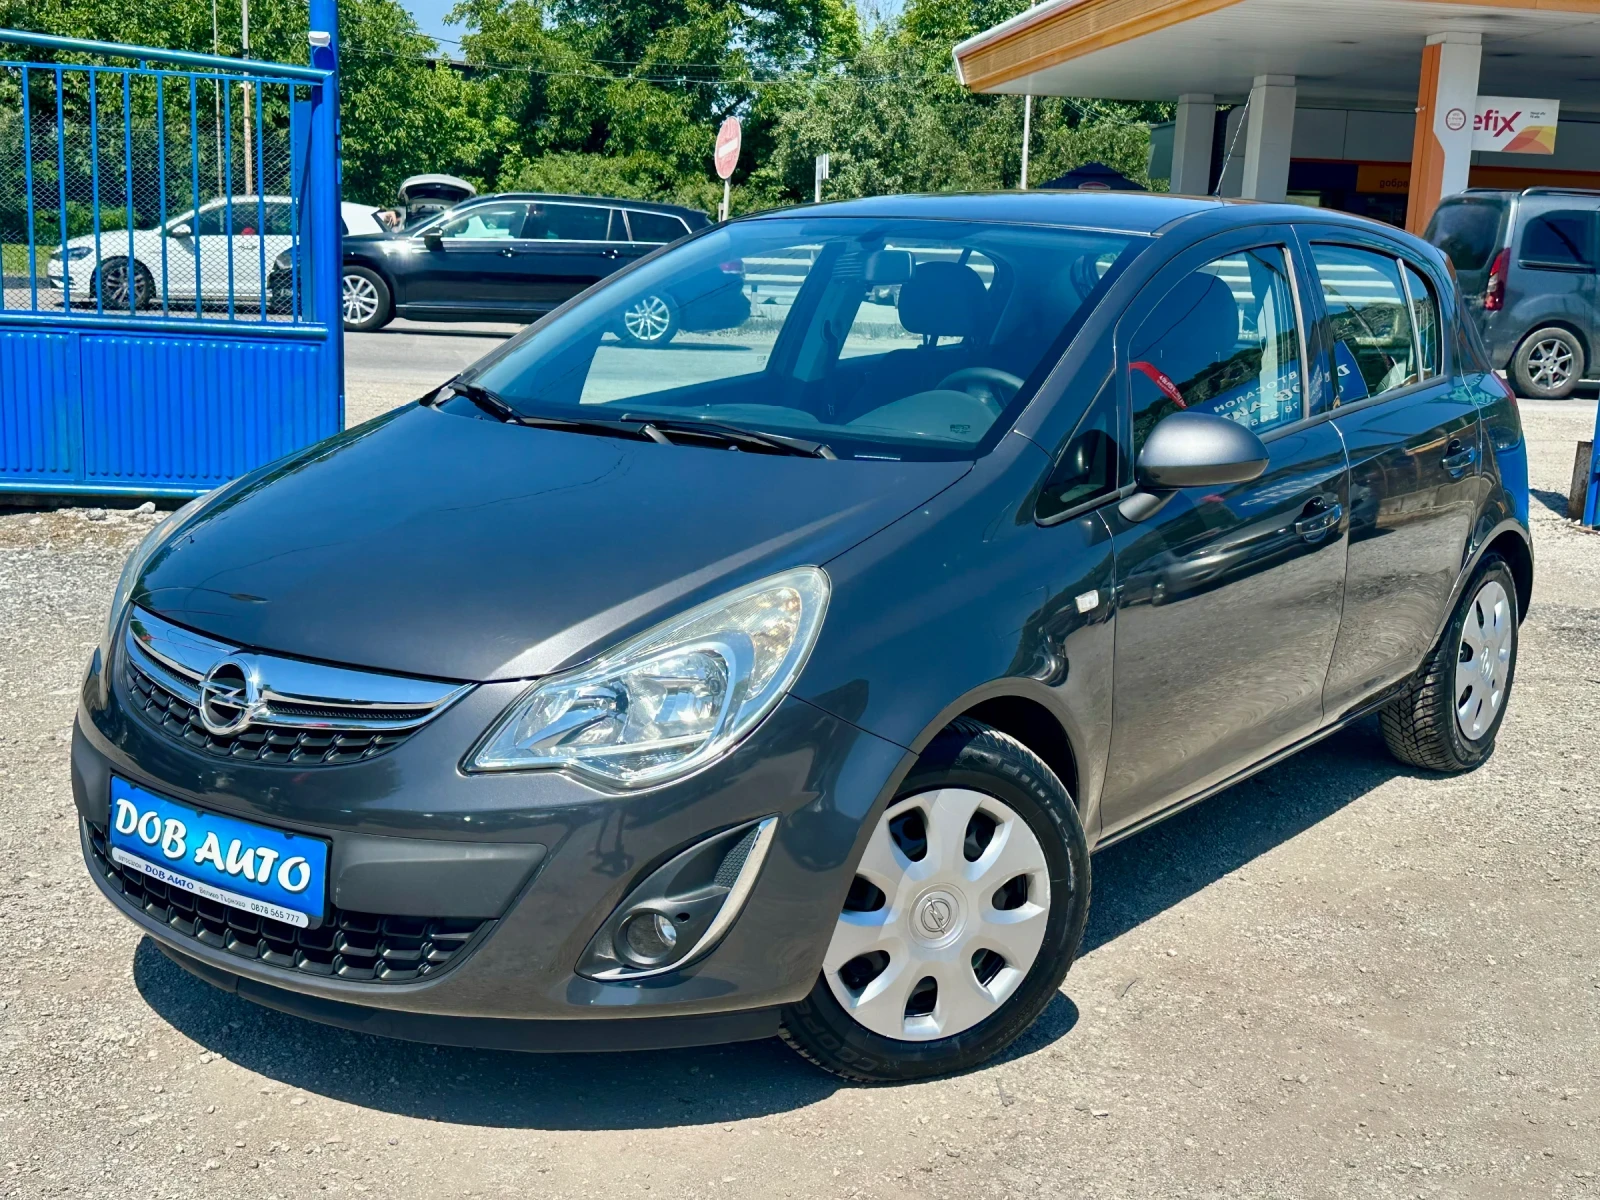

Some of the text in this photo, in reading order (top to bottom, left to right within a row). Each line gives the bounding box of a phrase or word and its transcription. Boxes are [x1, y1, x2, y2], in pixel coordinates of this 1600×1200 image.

[1473, 109, 1522, 137] efix
[115, 798, 311, 892] DOB AUTO
[145, 864, 194, 890] DOB AUTO
[251, 903, 300, 923] 0878 565 777
[794, 1000, 878, 1072] COOPE
